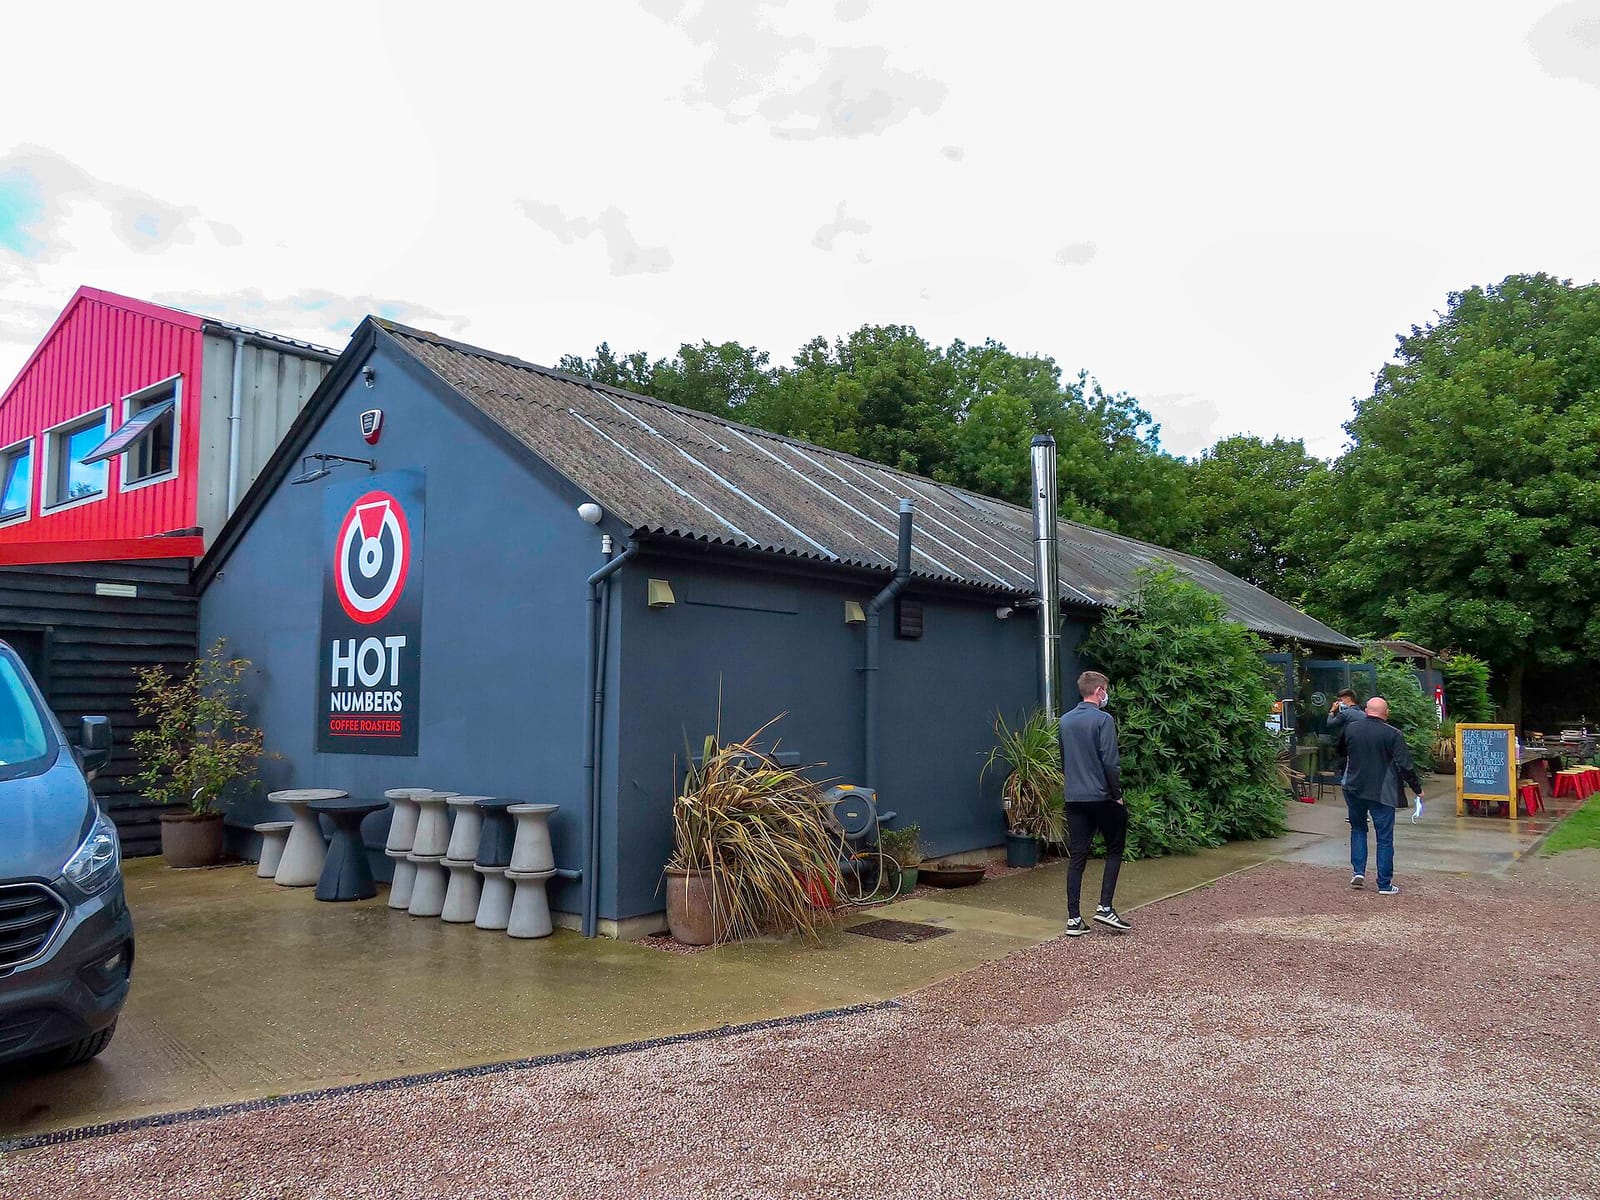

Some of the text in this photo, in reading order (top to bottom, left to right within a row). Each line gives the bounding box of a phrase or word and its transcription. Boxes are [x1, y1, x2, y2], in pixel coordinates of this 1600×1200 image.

[331, 635, 406, 687] HOT
[330, 690, 403, 712] NUMBERS
[330, 719, 401, 732] COFFEE ROASTERS
[1490, 751, 1504, 759] NEED
